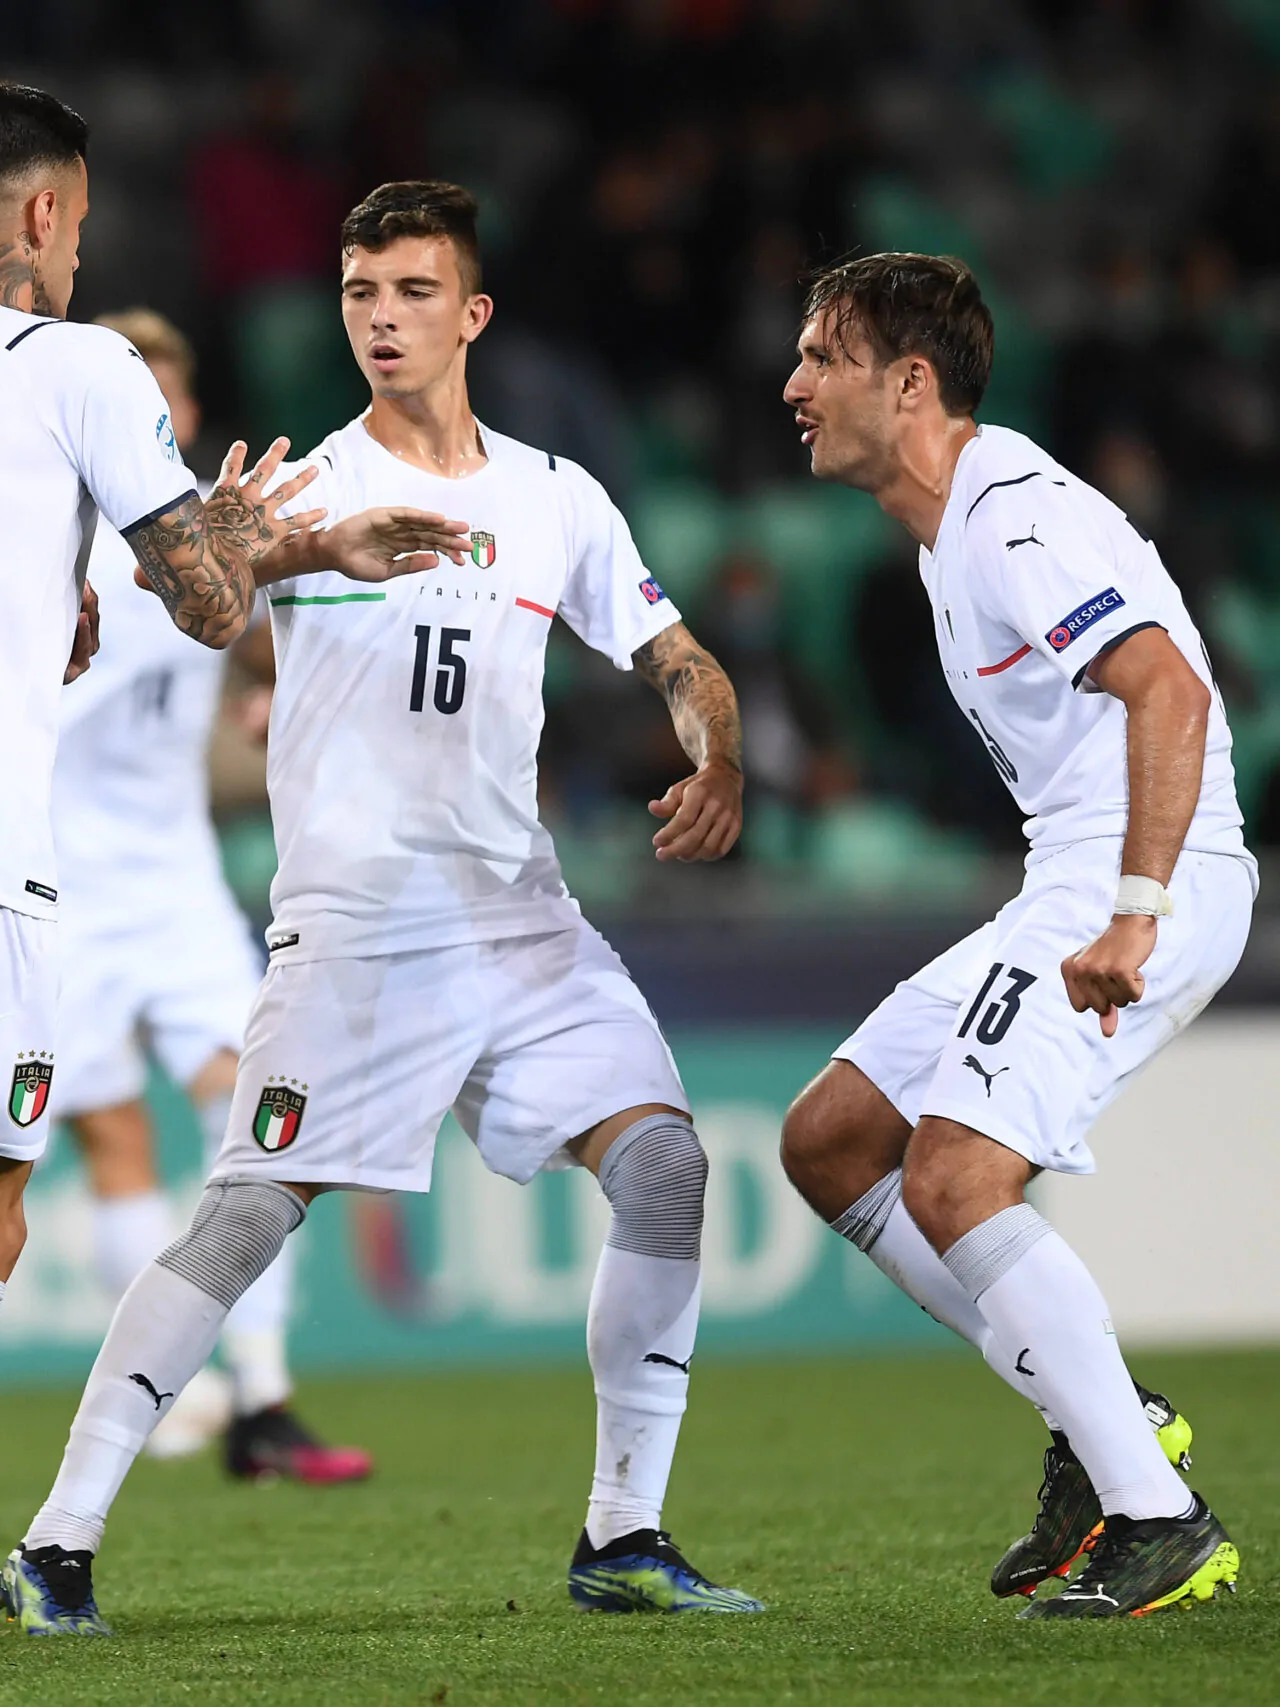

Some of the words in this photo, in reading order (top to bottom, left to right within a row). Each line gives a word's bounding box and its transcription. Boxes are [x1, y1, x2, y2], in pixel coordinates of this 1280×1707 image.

[1067, 591, 1121, 633] RESPECT
[409, 624, 472, 715] 15
[956, 962, 1039, 1046] 13
[16, 1066, 51, 1078] ITALIA
[263, 1090, 302, 1108] ITALIA
